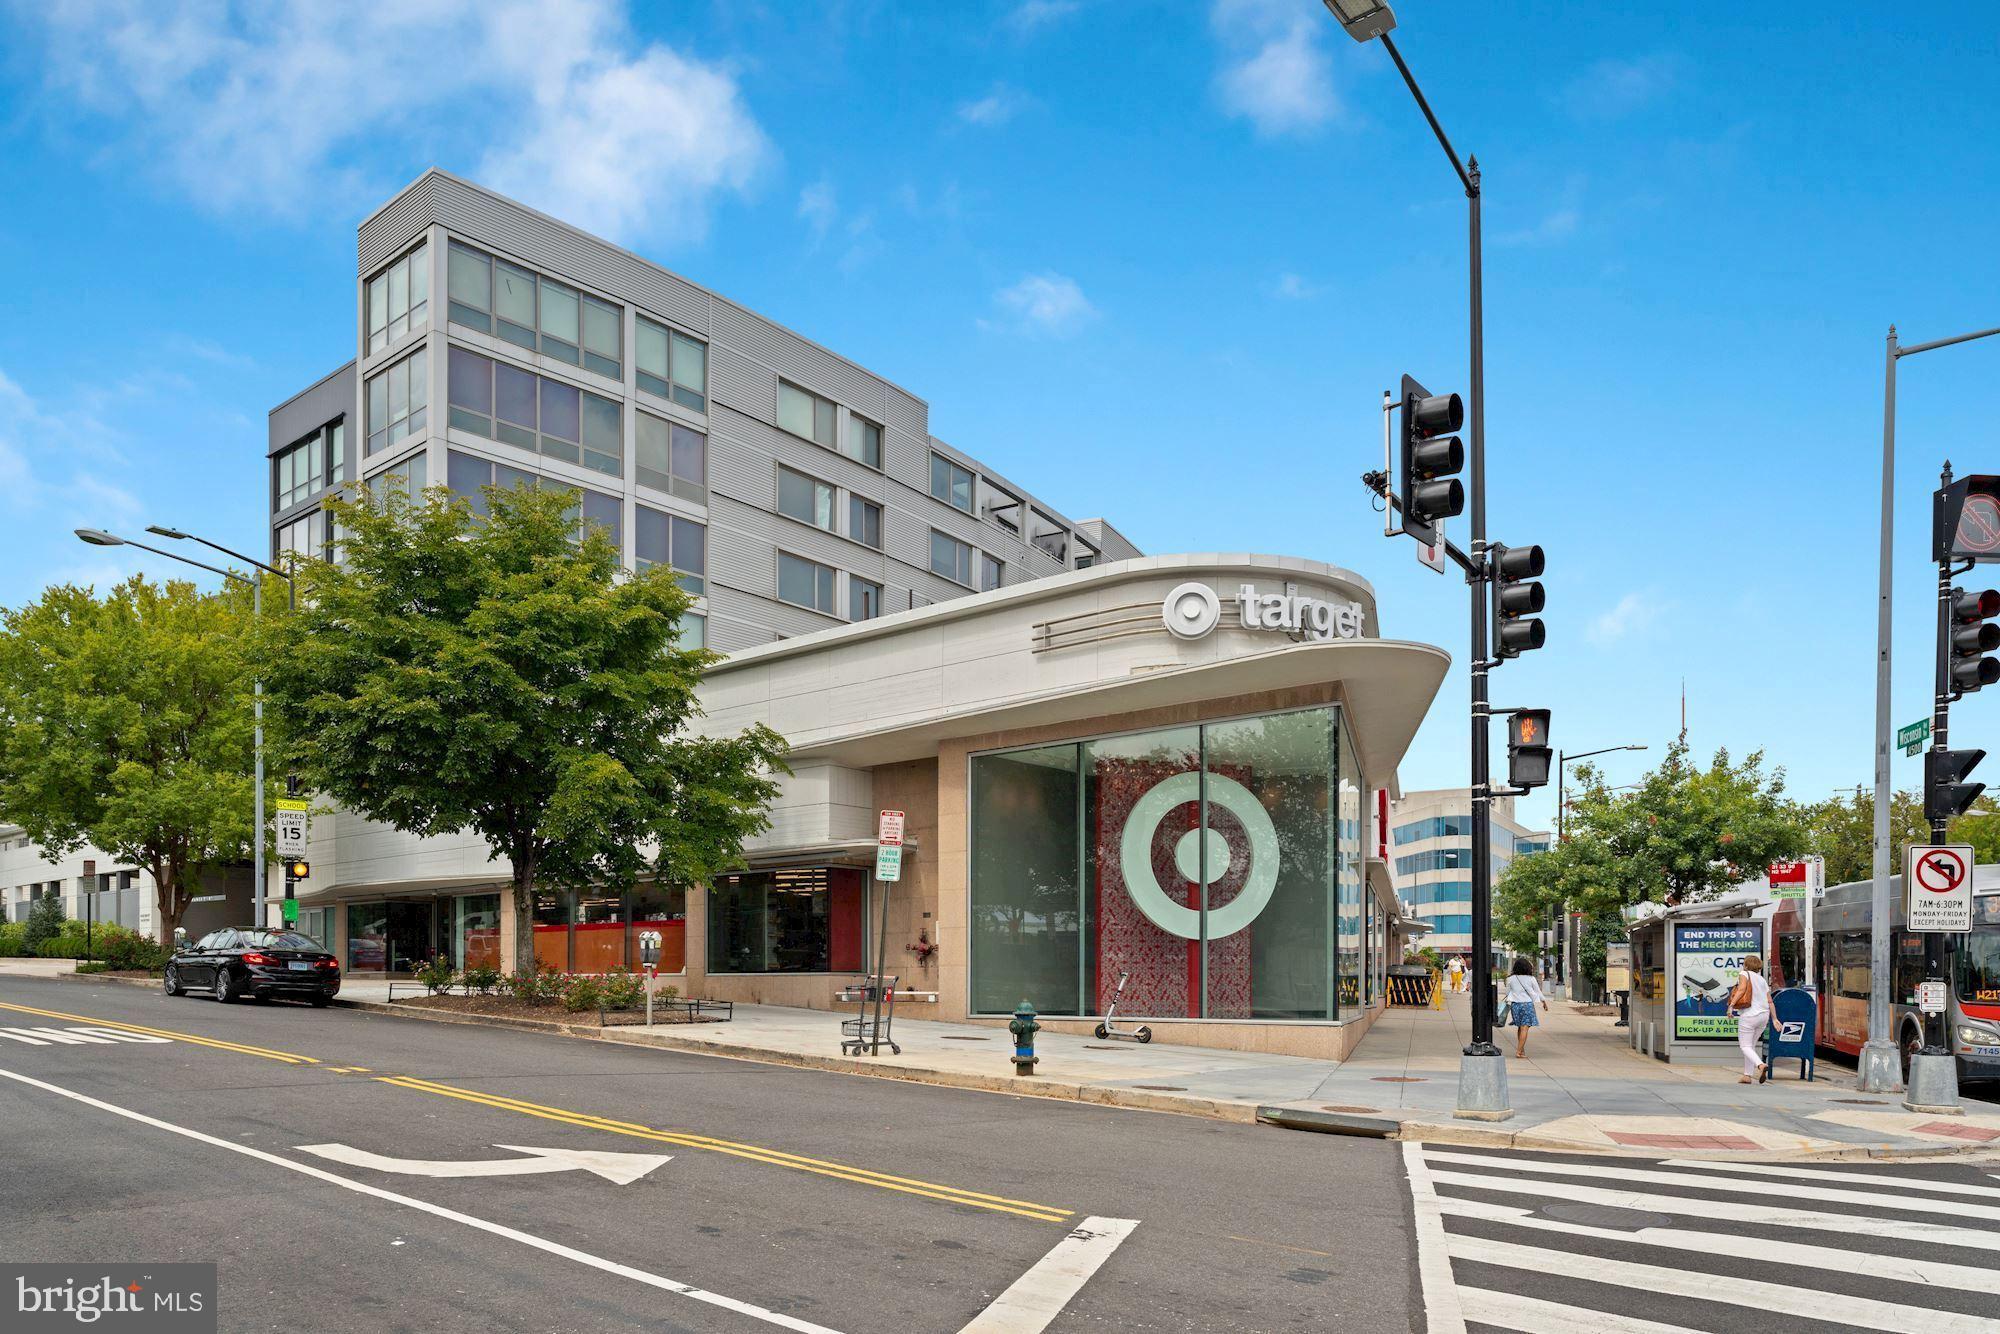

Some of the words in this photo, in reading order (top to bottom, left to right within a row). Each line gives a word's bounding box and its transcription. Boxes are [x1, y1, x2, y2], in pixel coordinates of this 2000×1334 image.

[1236, 583, 1365, 641] target
[278, 801, 304, 809] SCHOOL
[279, 812, 305, 820] SPEED
[282, 827, 301, 840] 15
[886, 849, 898, 857] HOUR
[1918, 900, 1963, 909] 7AM-6:30PM
[1684, 931, 1705, 939] END
[1708, 931, 1736, 939] TRIPS
[1701, 941, 1758, 949] MECHANIC.
[1977, 1047, 2000, 1055] 7145
